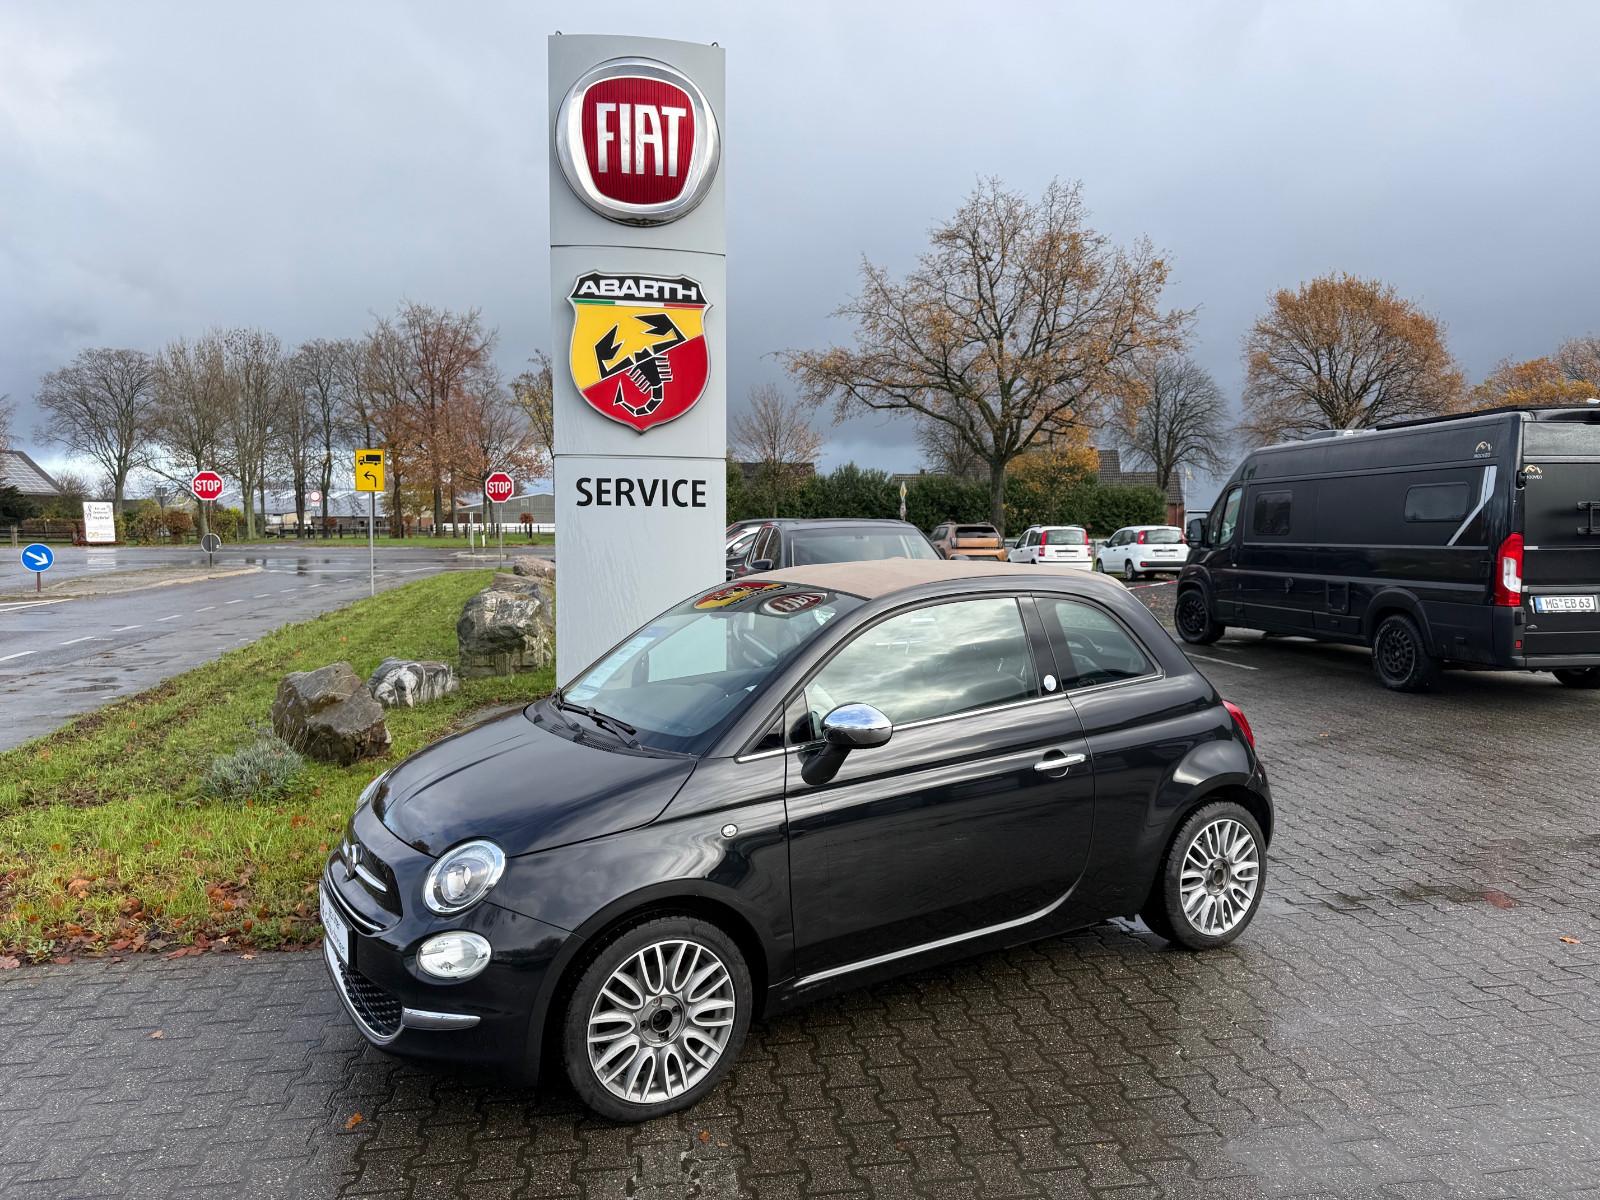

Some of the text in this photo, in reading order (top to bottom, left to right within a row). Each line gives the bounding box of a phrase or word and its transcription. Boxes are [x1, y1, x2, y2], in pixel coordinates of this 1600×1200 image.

[596, 102, 687, 177] FIAT
[578, 278, 698, 301] ABARTH
[195, 480, 220, 492] STOP
[489, 481, 510, 493] STOP
[576, 477, 707, 508] SERVICE
[1578, 598, 1591, 609] 63
